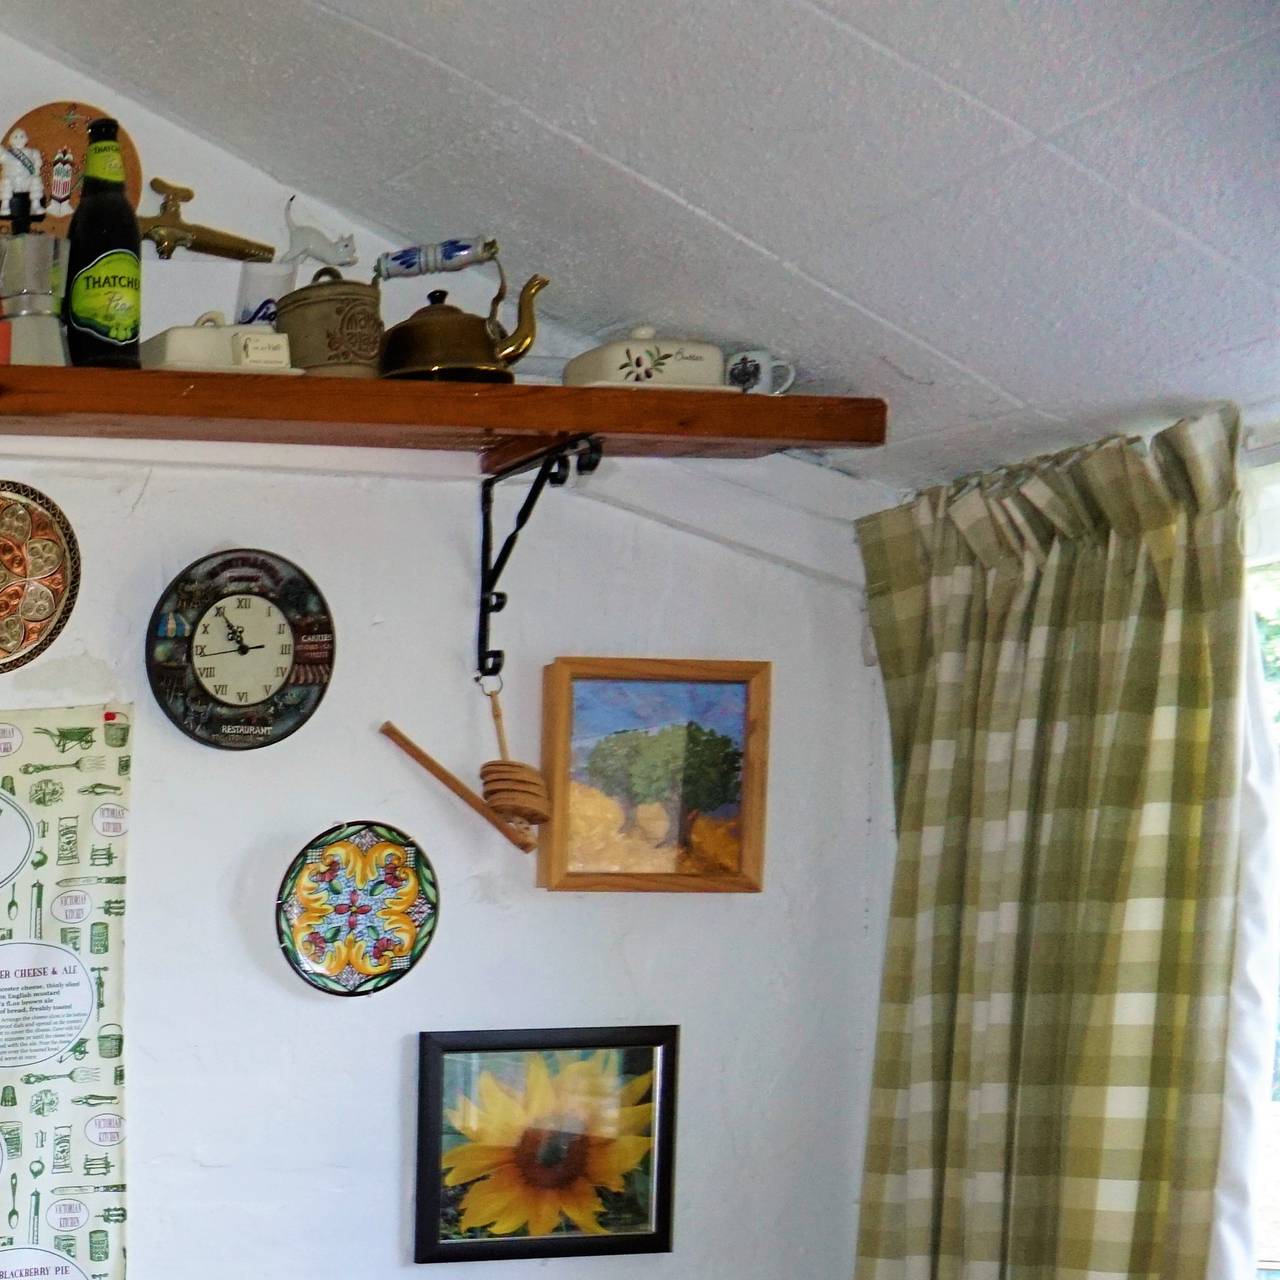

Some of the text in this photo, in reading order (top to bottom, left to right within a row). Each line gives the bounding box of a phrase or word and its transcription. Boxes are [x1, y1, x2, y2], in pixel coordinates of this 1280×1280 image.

[221, 725, 273, 735] RESTAURANT
[14, 966, 48, 978] CHEESE
[0, 1266, 51, 1280] BLACKBERRY
[55, 1265, 70, 1275] PIE
